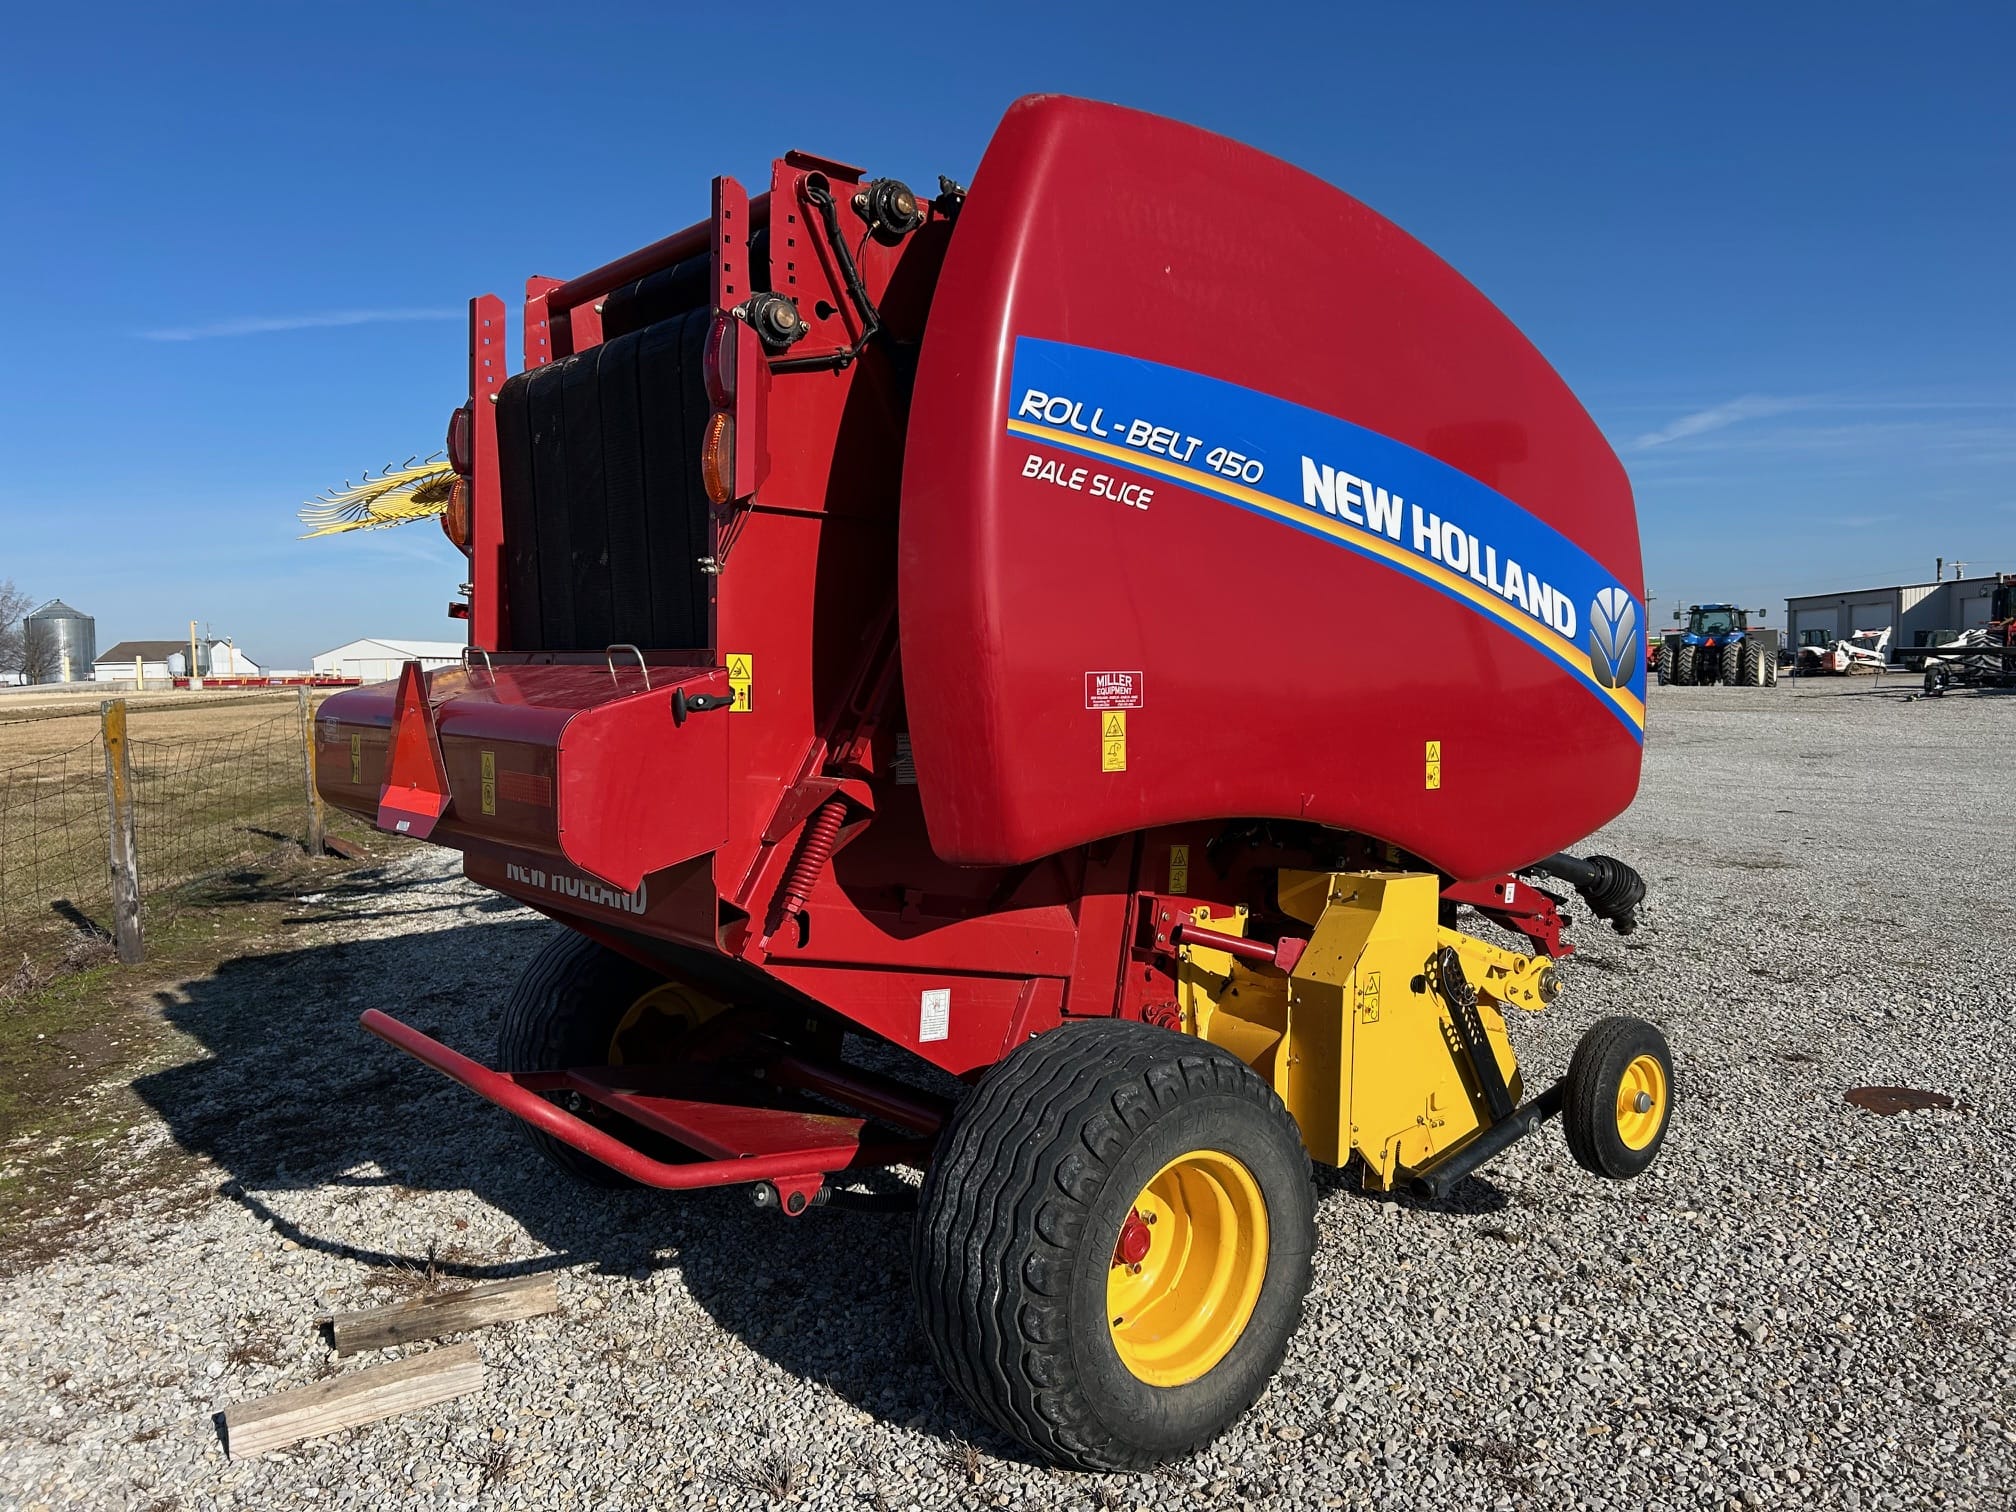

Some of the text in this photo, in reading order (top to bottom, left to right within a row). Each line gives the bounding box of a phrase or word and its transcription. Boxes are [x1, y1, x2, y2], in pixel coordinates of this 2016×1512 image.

[1018, 389, 1264, 484] ROLL-BELT 450
[1022, 454, 1155, 511] BALE SLICE
[1302, 455, 1577, 639] NEW HOLLAND
[1096, 674, 1132, 687] MILLER
[1096, 686, 1132, 695] EQUIPMENT
[506, 863, 546, 888] NEW
